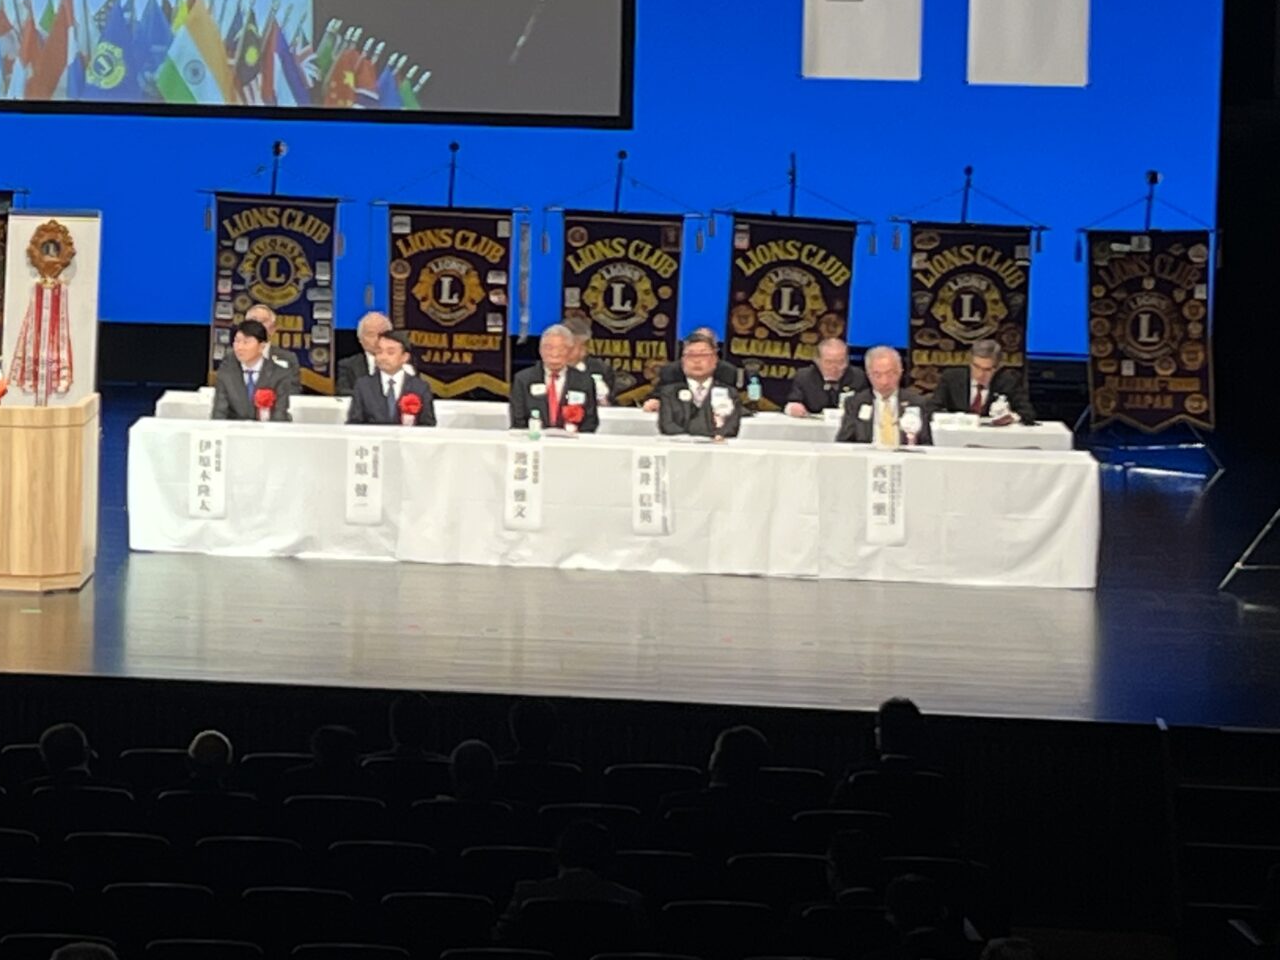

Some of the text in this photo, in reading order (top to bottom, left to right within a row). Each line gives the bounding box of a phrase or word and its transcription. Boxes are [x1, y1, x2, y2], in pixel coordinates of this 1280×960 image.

[222, 207, 331, 244] LIONS CLUB
[396, 228, 506, 263] LIONS CLUB
[566, 237, 678, 278] LIONS CLUB
[266, 257, 286, 284] L
[735, 240, 851, 287] LIONS CLUB
[914, 245, 1026, 289] LIONS CLUB
[439, 276, 459, 304] L
[610, 282, 632, 311] L
[779, 287, 800, 316] L
[960, 294, 981, 321] L
[1138, 313, 1160, 341] L
[421, 350, 474, 364] JAPAN
